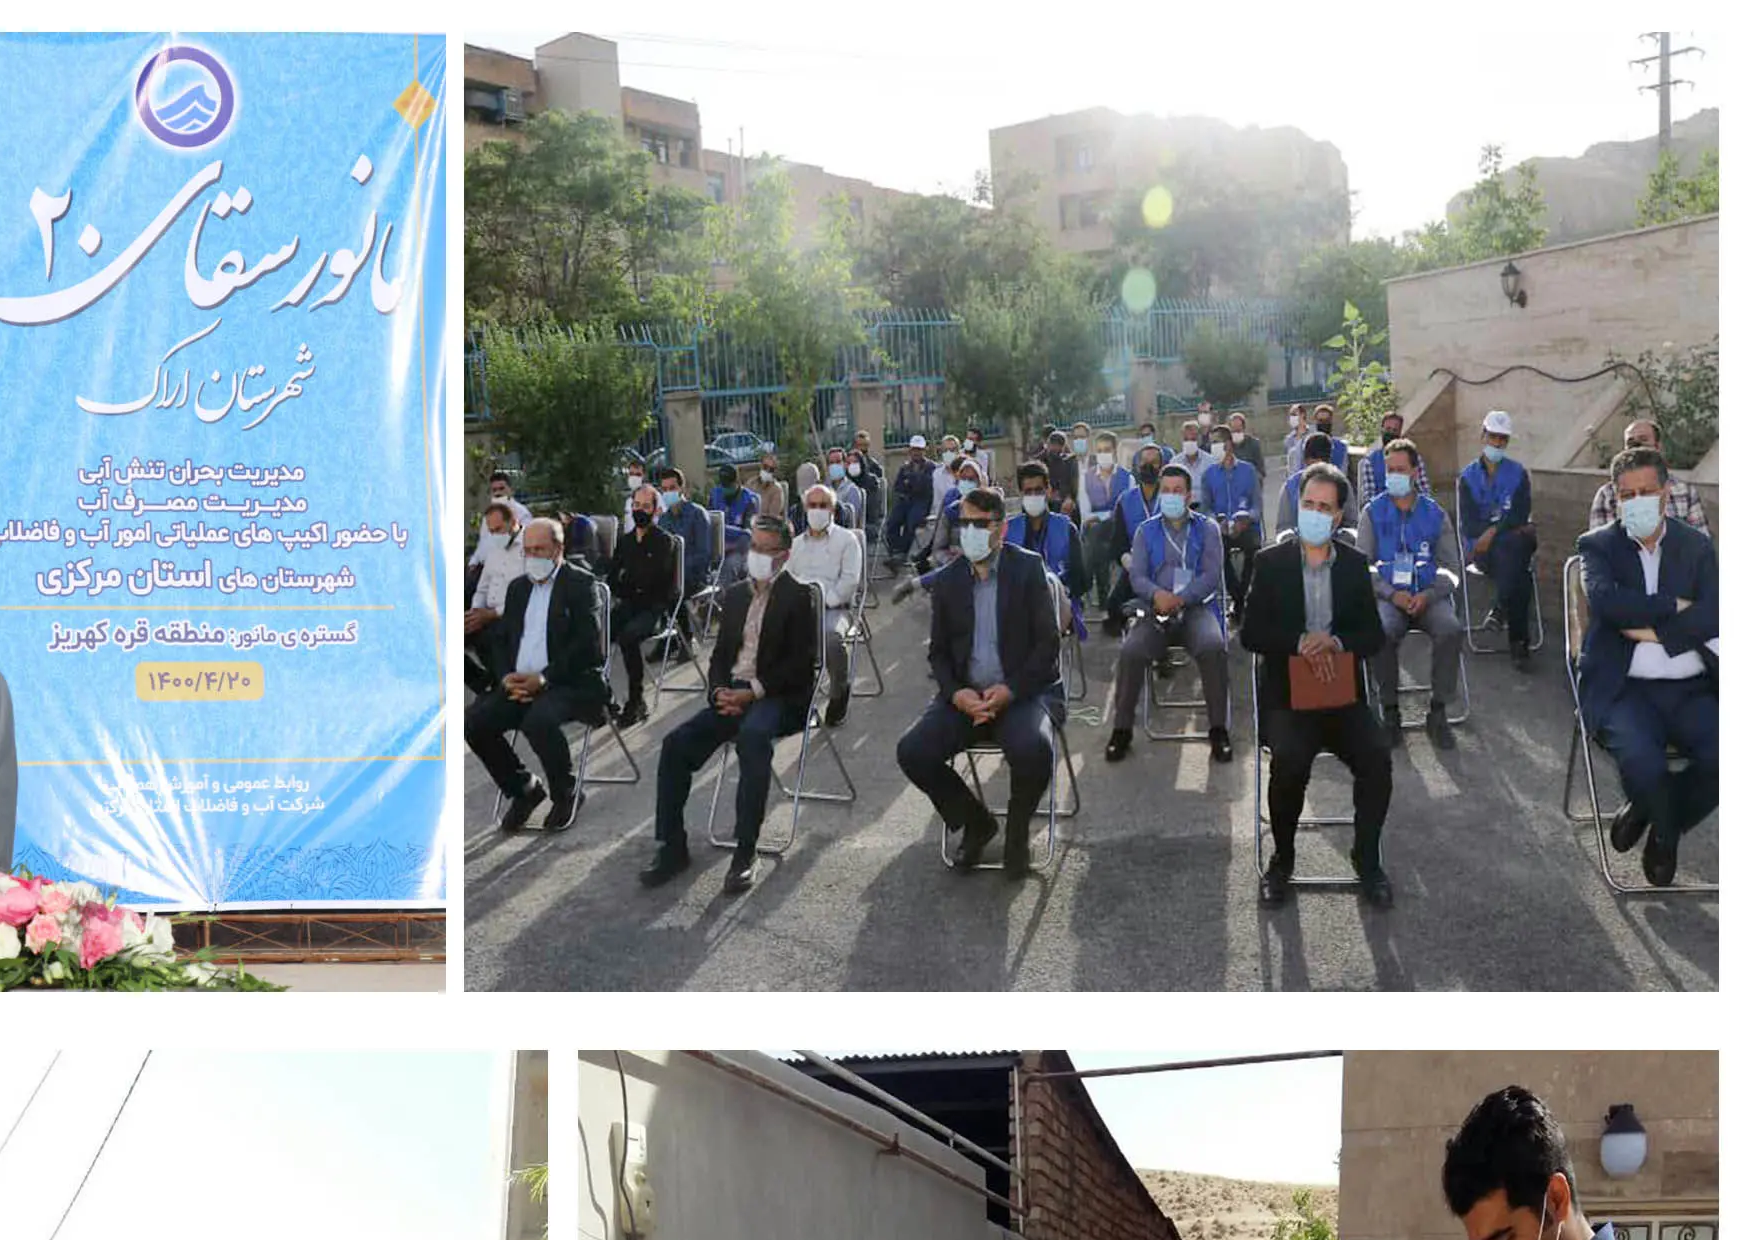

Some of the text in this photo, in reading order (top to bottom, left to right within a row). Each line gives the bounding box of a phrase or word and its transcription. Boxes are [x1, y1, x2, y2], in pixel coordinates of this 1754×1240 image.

[29, 186, 103, 283] ۲۰
[271, 154, 403, 314] مانور
[75, 317, 317, 431] شهرستان اراک
[78, 457, 305, 487] مدیریت بحران تنش آبی
[77, 487, 307, 517] مدیریت مصرف آب
[64, 528, 76, 549] و
[79, 518, 111, 547] آب
[113, 521, 151, 549] امور
[155, 521, 229, 548] عملیاتی
[234, 522, 272, 549] های
[277, 521, 328, 552] اکیپ
[332, 523, 388, 548] حضور
[392, 521, 407, 549] با
[36, 558, 355, 596] شهرستان های استان مرکزی
[48, 620, 357, 650] گستره ی مانور: منطقه قره کهریز
[148, 671, 251, 692] ۱۴۰۰/۴/۲۰
[212, 779, 220, 793] و
[223, 778, 270, 793] عمومی
[275, 774, 309, 792] روابط
[184, 796, 238, 813] فاضلاب
[241, 802, 250, 815] و
[253, 796, 274, 815] آب
[277, 796, 325, 814] شرکت
